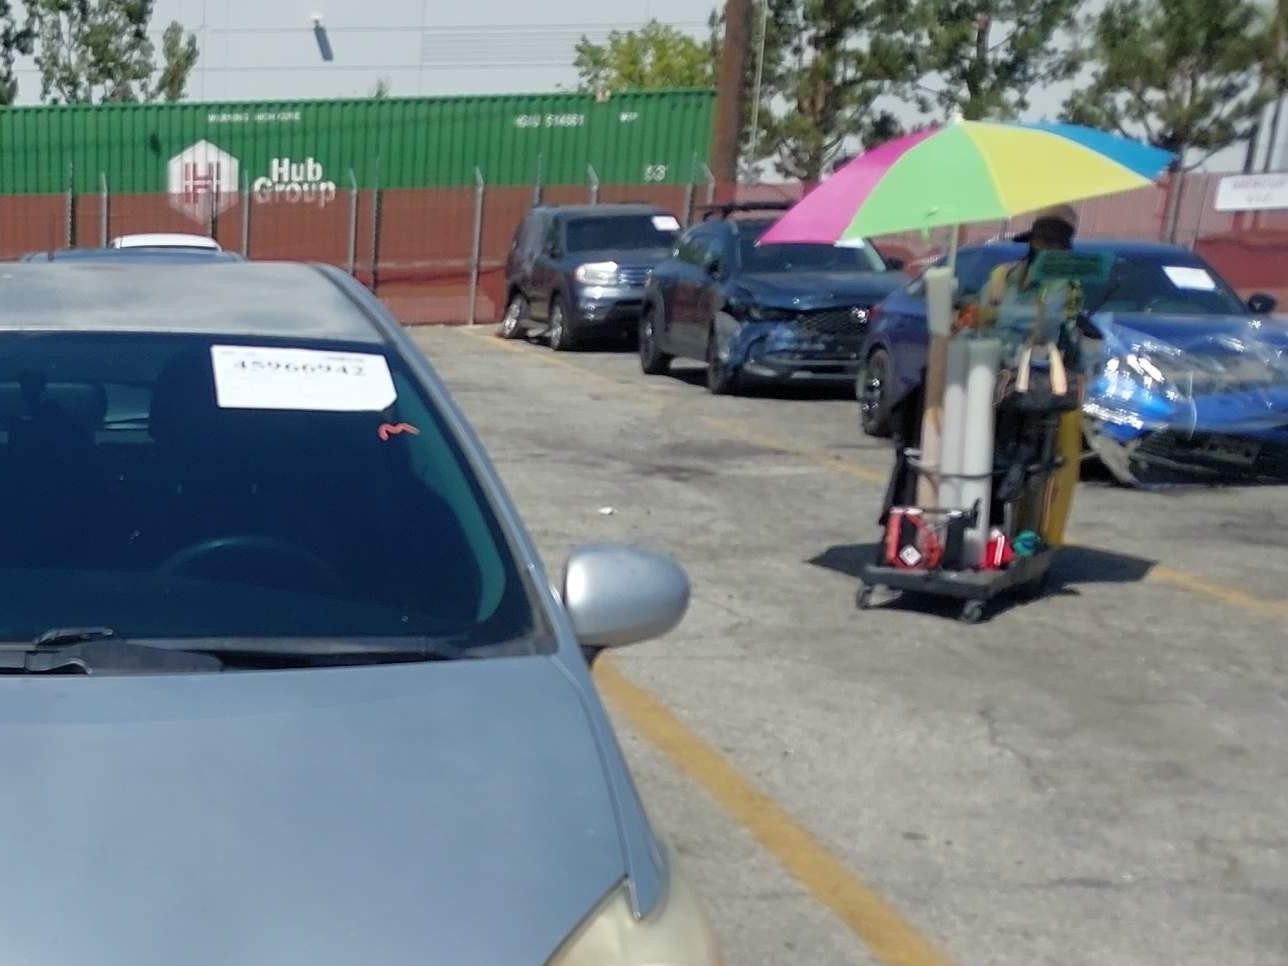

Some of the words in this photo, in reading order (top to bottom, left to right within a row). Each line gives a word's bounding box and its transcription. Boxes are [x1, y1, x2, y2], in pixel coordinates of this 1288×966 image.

[271, 157, 323, 182] Hub
[253, 176, 336, 208] Group
[234, 360, 368, 376] 45966942
